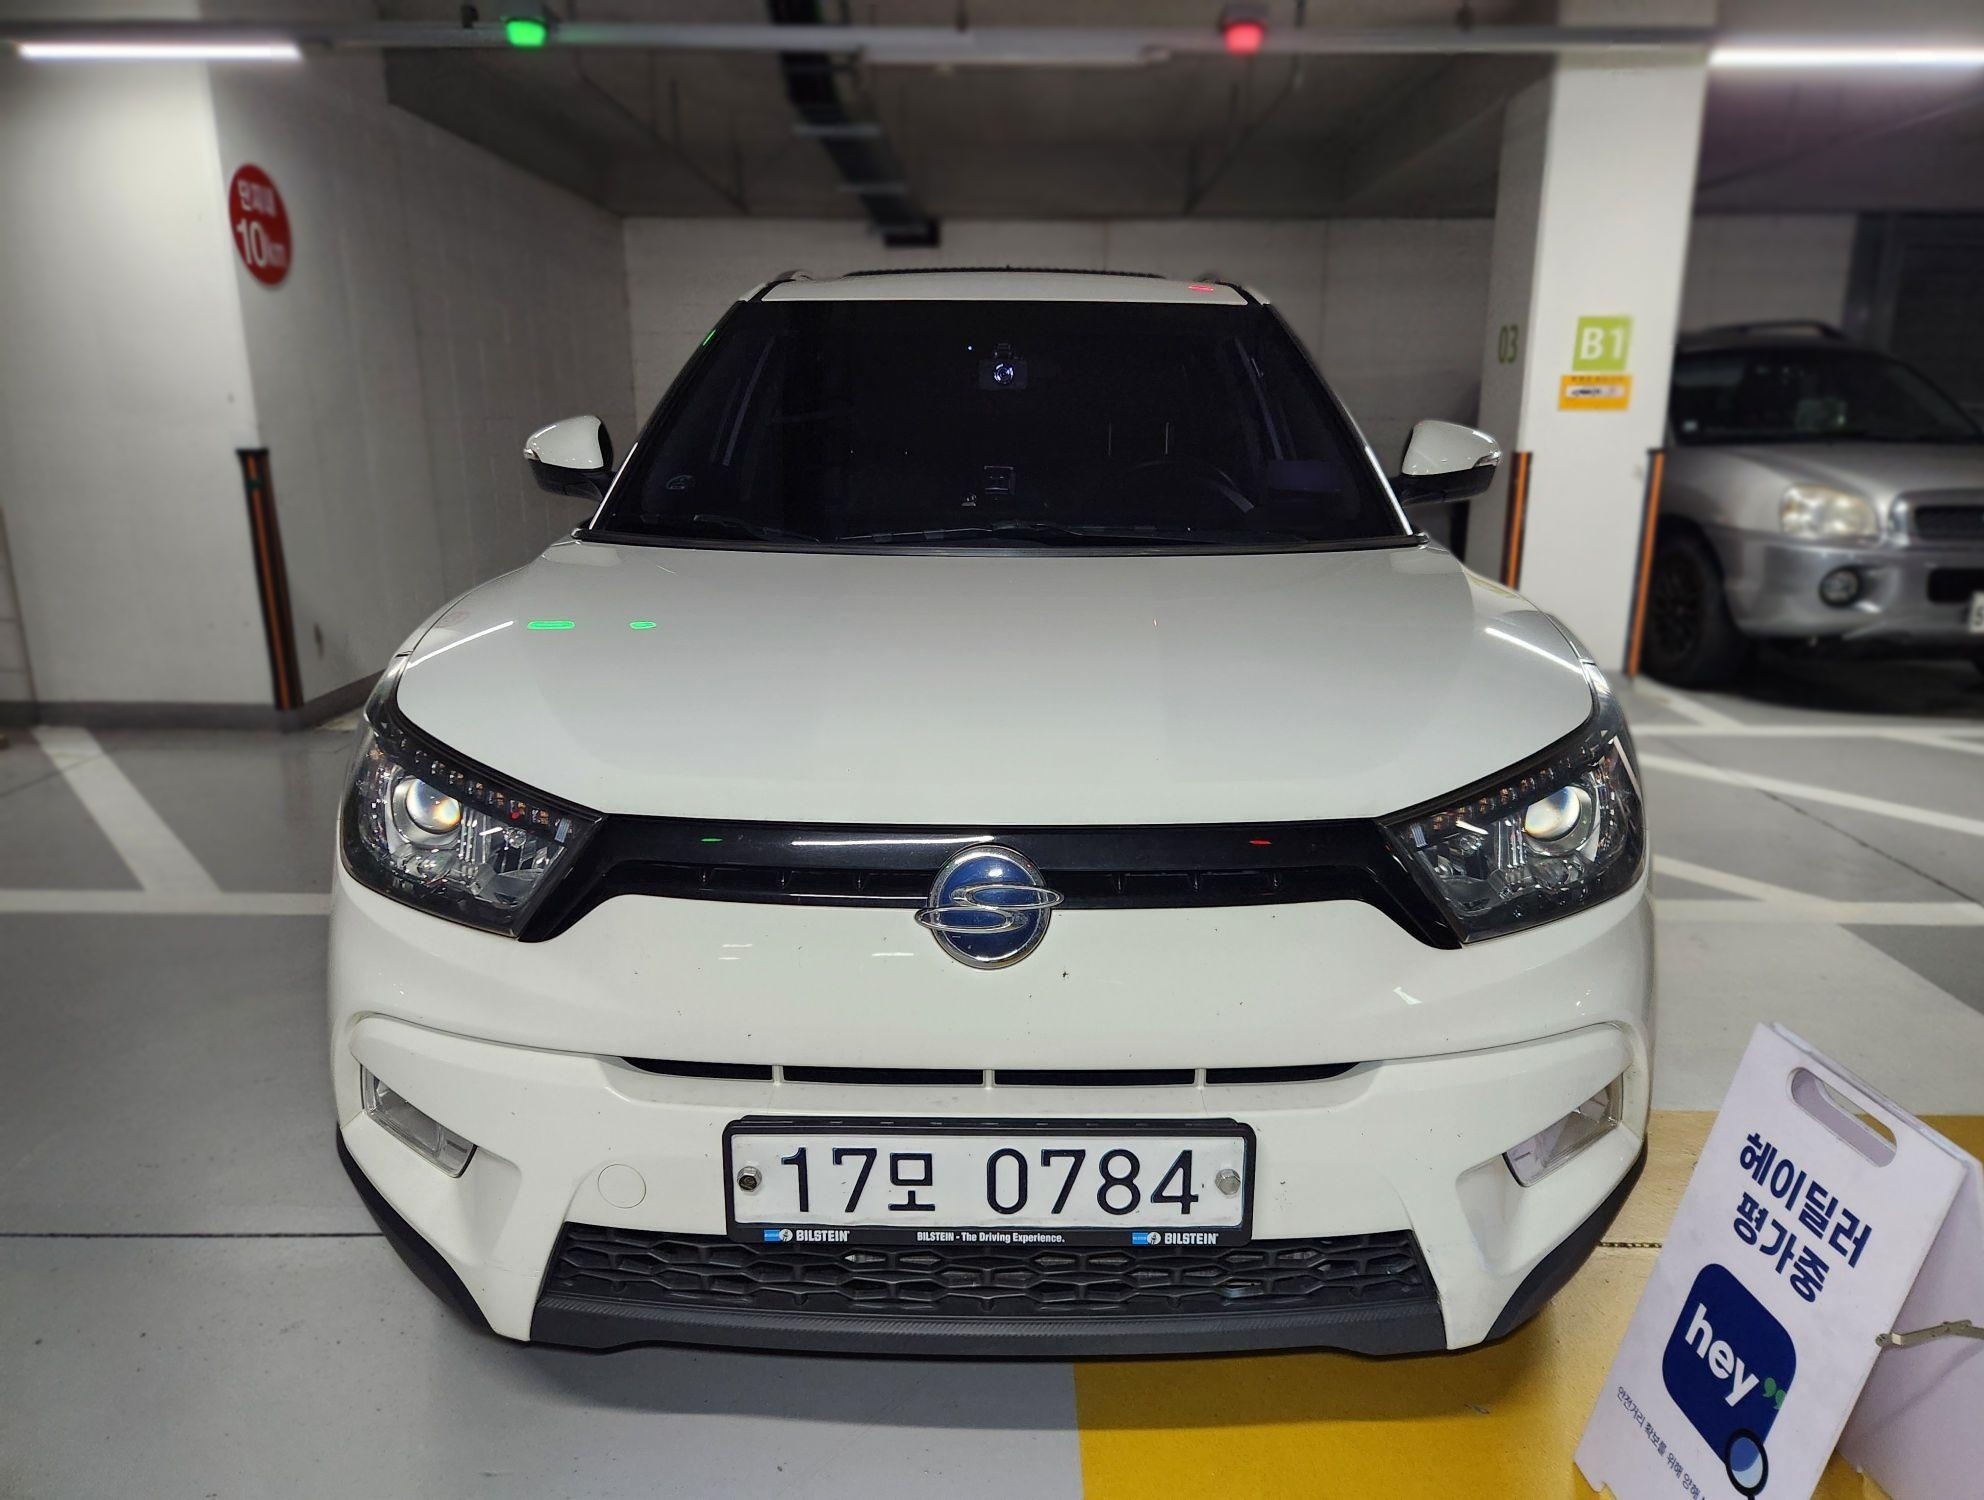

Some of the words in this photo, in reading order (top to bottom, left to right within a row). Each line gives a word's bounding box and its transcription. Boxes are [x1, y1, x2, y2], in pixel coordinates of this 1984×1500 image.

[1498, 324, 1519, 364] 03
[1580, 326, 1625, 361] B1
[781, 1147, 936, 1213] 17모
[986, 1148, 1199, 1215] 0784
[1739, 1133, 1873, 1268] 헤이딜러
[796, 1230, 848, 1242] BILSTEIN
[917, 1232, 954, 1241] BILSTEIN
[961, 1232, 977, 1242] The
[979, 1232, 1011, 1244] Driving
[1012, 1233, 1065, 1244] Experience.
[1164, 1233, 1217, 1244] BILSTEIN
[1733, 1192, 1831, 1303] 평가중
[1685, 1303, 1760, 1407] hey
[1617, 1386, 1646, 1428] 안전거리
[1645, 1421, 1667, 1457] 확보를
[1666, 1452, 1683, 1479] 위해
